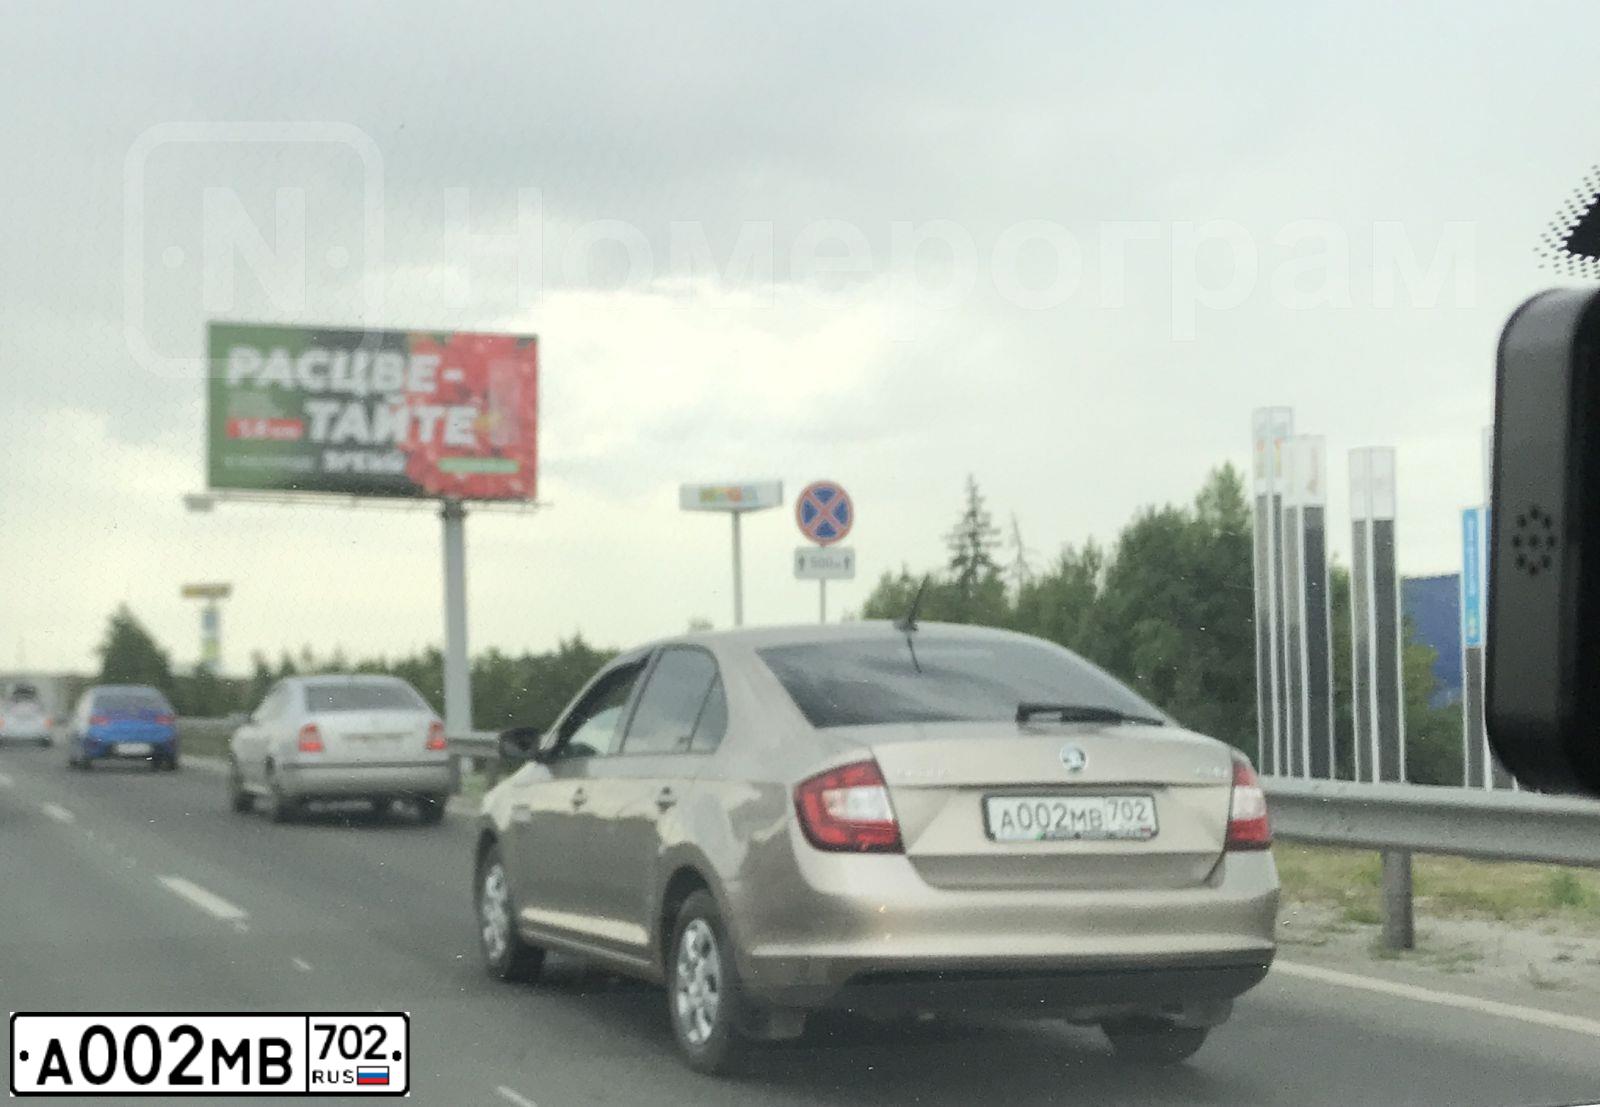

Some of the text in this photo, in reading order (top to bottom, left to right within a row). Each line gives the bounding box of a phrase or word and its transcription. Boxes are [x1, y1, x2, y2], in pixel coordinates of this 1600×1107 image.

[225, 346, 464, 396] РАСЦВЕ-
[303, 395, 478, 446] ТАЙТЕ
[1108, 799, 1148, 822] 702
